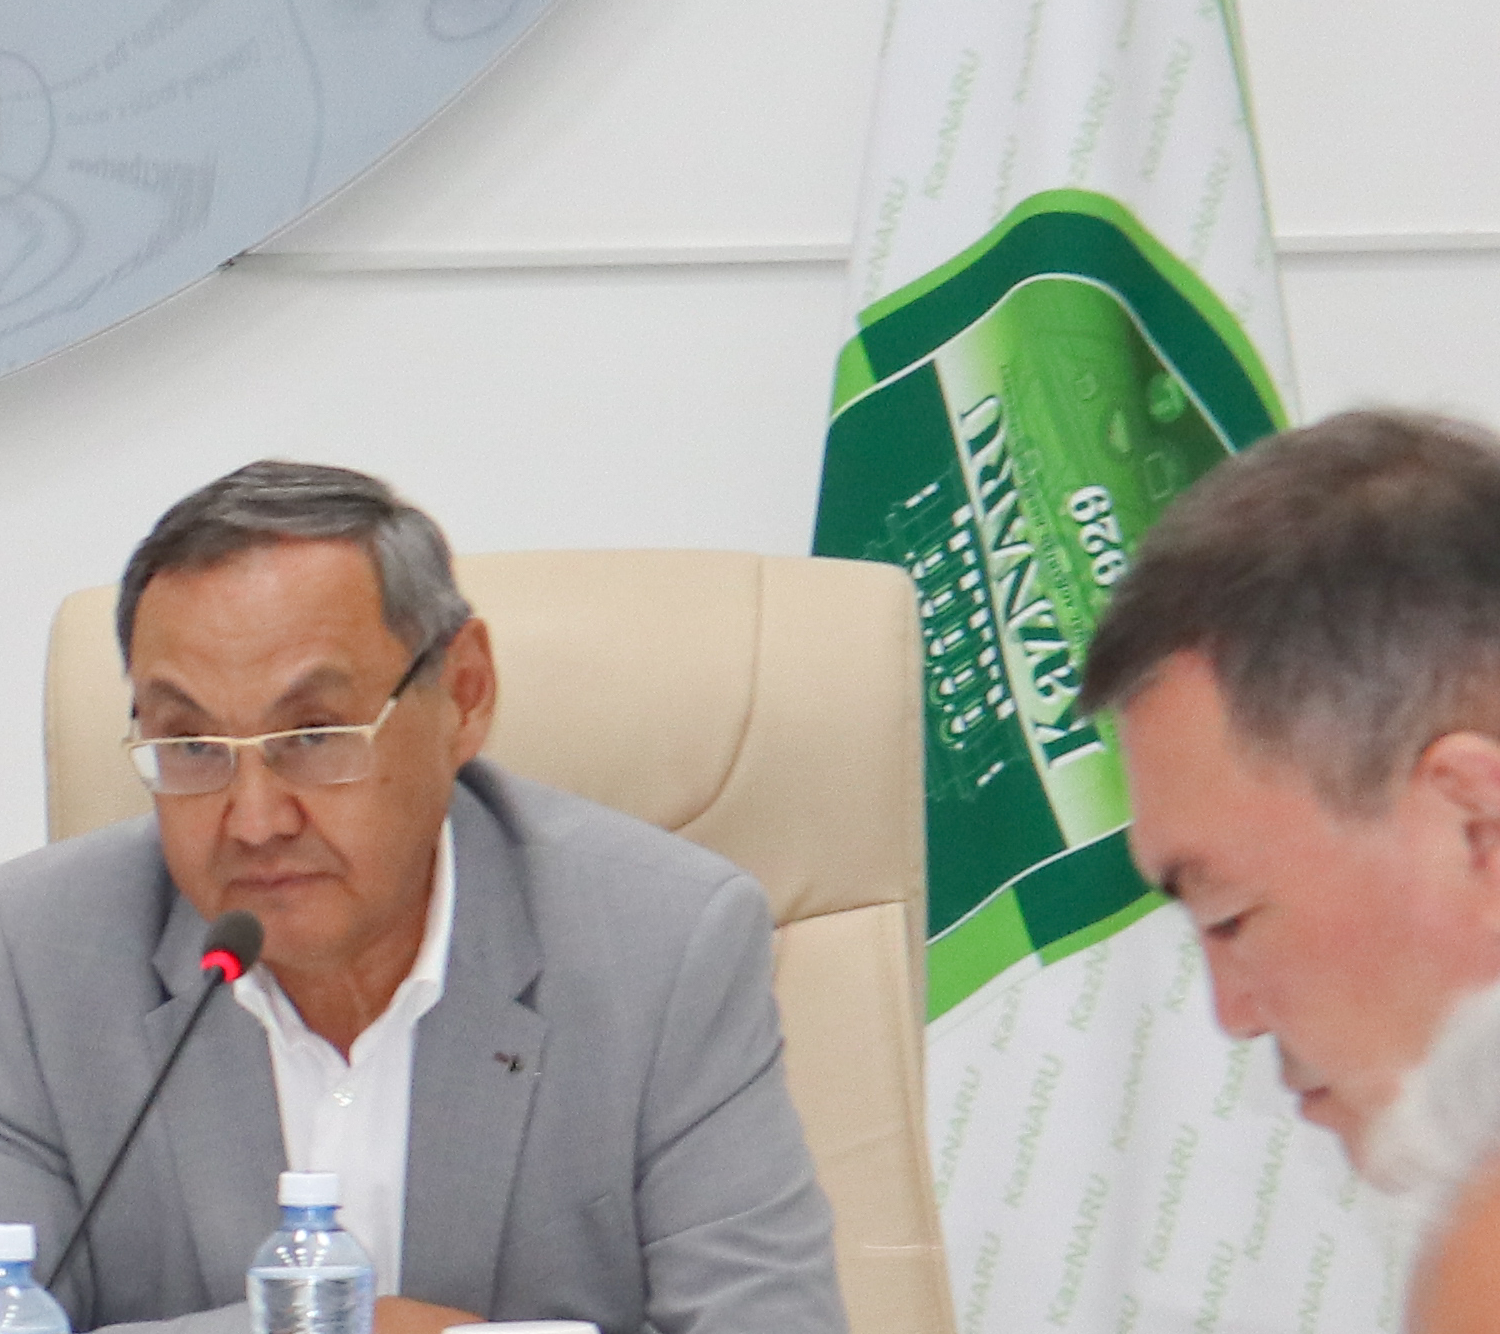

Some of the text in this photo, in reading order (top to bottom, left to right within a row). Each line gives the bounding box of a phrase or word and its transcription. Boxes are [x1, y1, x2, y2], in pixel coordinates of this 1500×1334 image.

[922, 48, 980, 200] KazNARU
[1141, 38, 1193, 183] KazNARU
[1067, 484, 1130, 587] 929
[934, 1065, 981, 1205] azNARU
[1004, 1052, 1063, 1209] KazNARU
[1145, 1123, 1199, 1273] KazNARU
[1046, 1173, 1110, 1327] KazNARU
